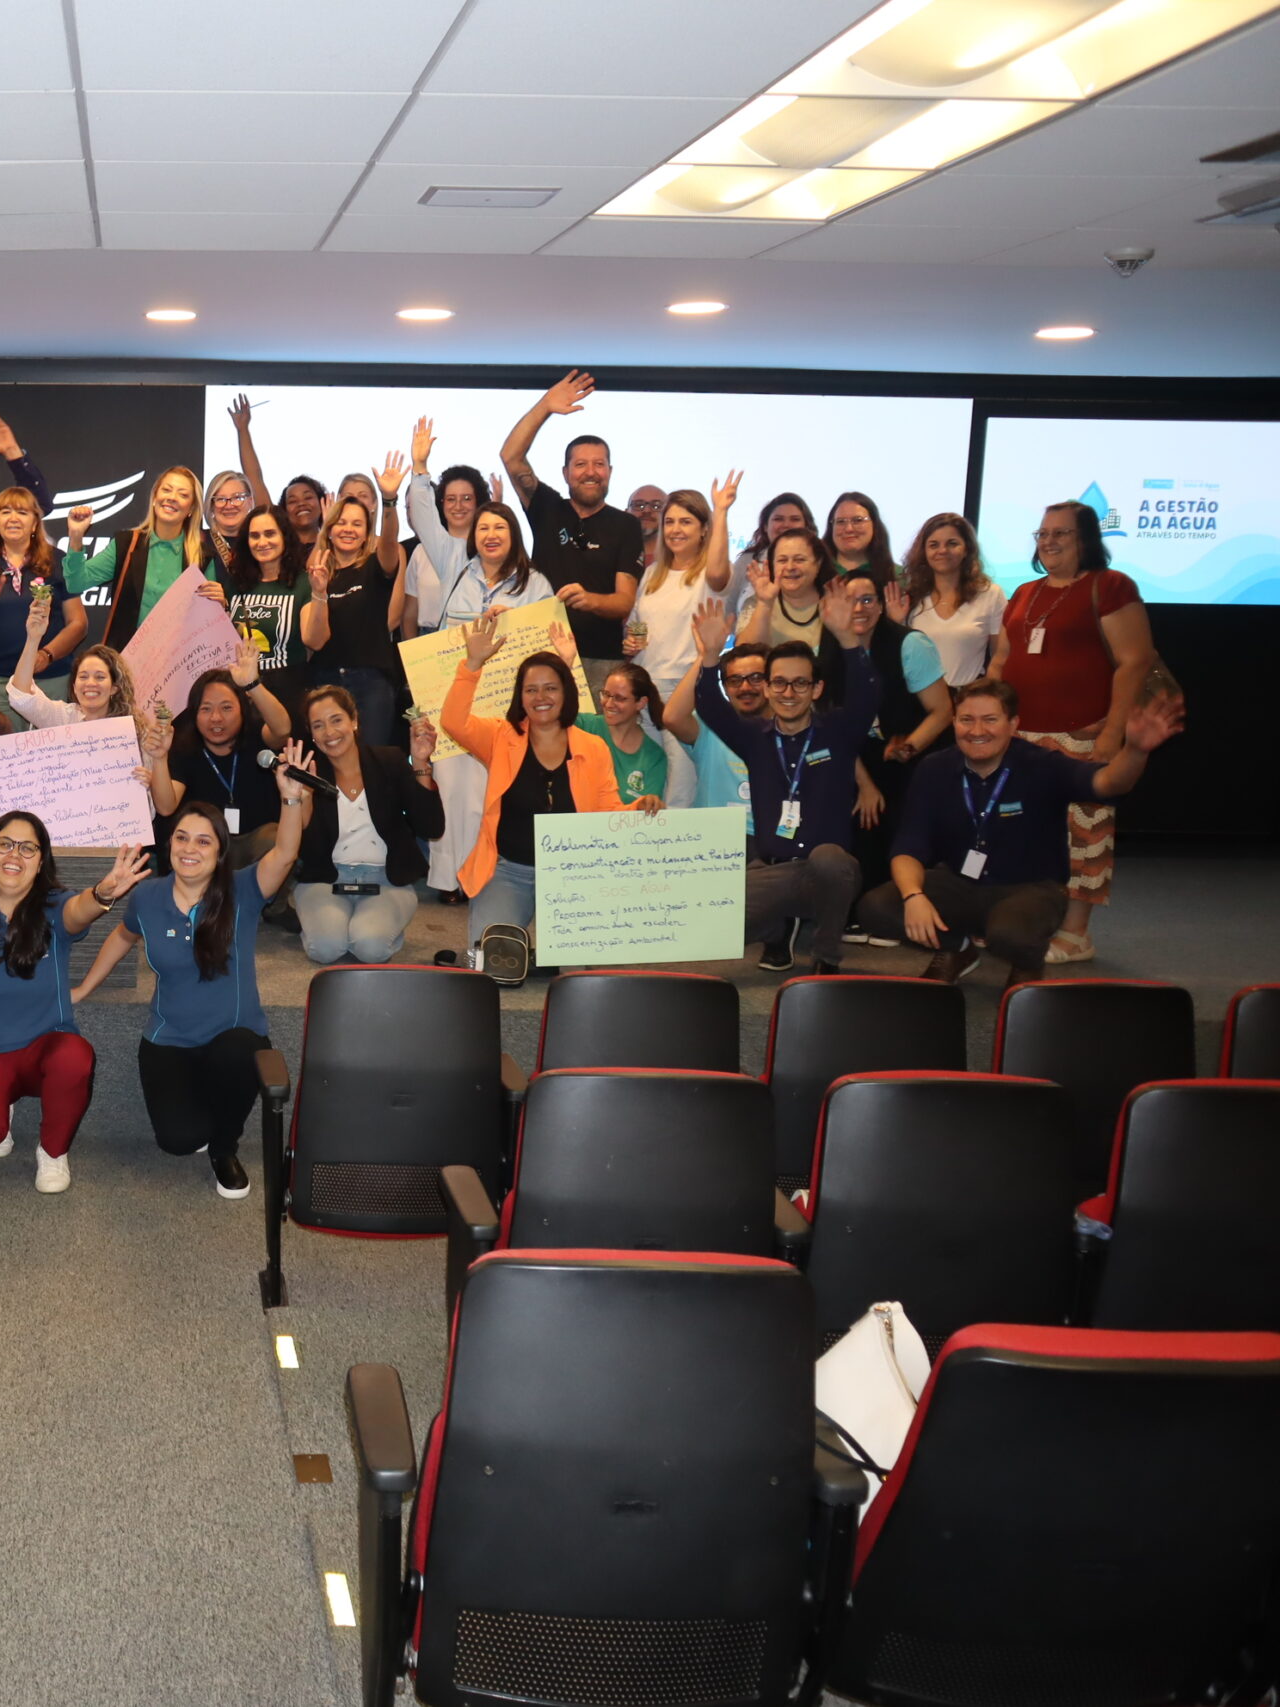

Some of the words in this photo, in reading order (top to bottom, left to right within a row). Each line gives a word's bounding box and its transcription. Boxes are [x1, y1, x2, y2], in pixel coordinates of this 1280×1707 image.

[1139, 500, 1150, 512] A
[1155, 497, 1219, 513] GESTÃO
[1138, 515, 1162, 529] DA
[1167, 513, 1217, 530] ÁGUA
[1188, 532, 1217, 540] TEMPO
[15, 728, 56, 759] GRUPO
[607, 812, 653, 833] GRUPO
[599, 886, 632, 898] SOS
